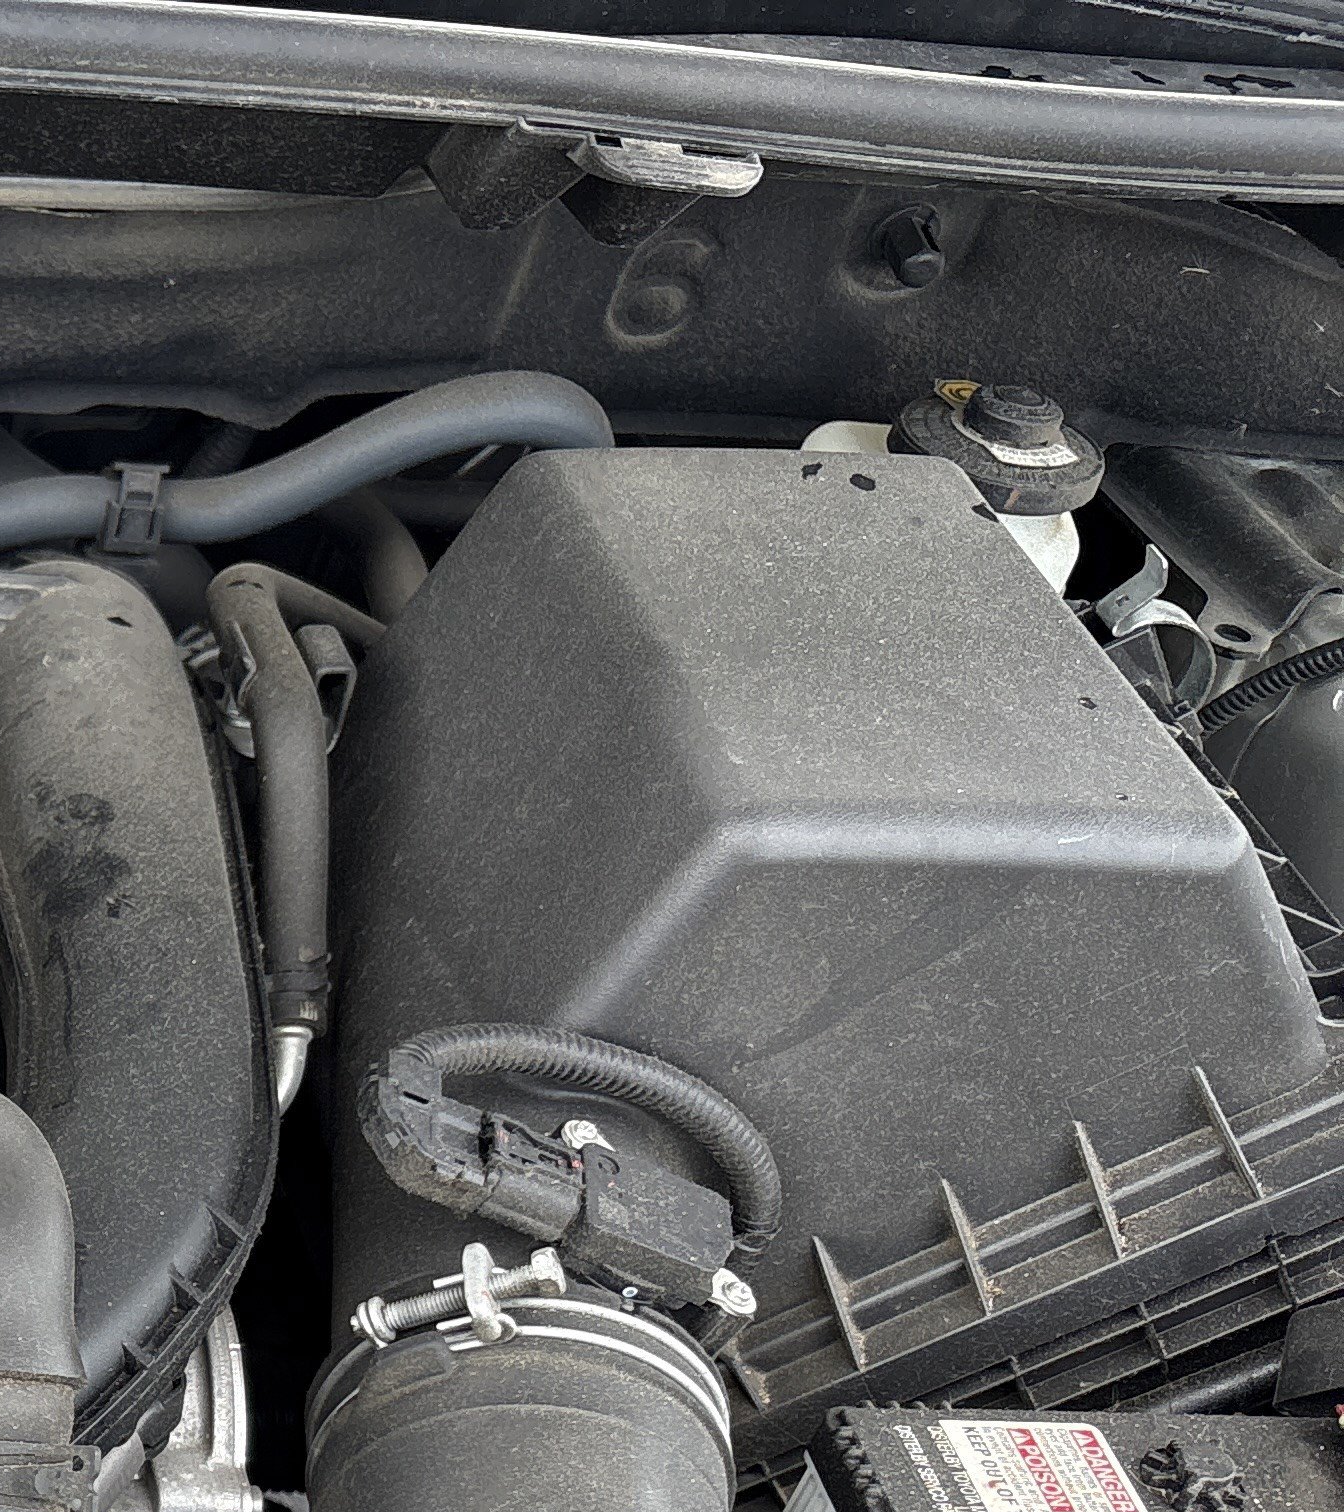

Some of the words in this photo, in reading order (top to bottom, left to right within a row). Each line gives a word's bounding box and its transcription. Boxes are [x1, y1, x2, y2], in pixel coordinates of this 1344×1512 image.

[915, 1467, 950, 1502] SERVCO
[949, 1471, 983, 1505] TOYOTA
[960, 1425, 992, 1456] KEEP
[978, 1459, 1009, 1487] OUT
[994, 1488, 1020, 1506] OF
[1078, 1446, 1137, 1512] DANGER
